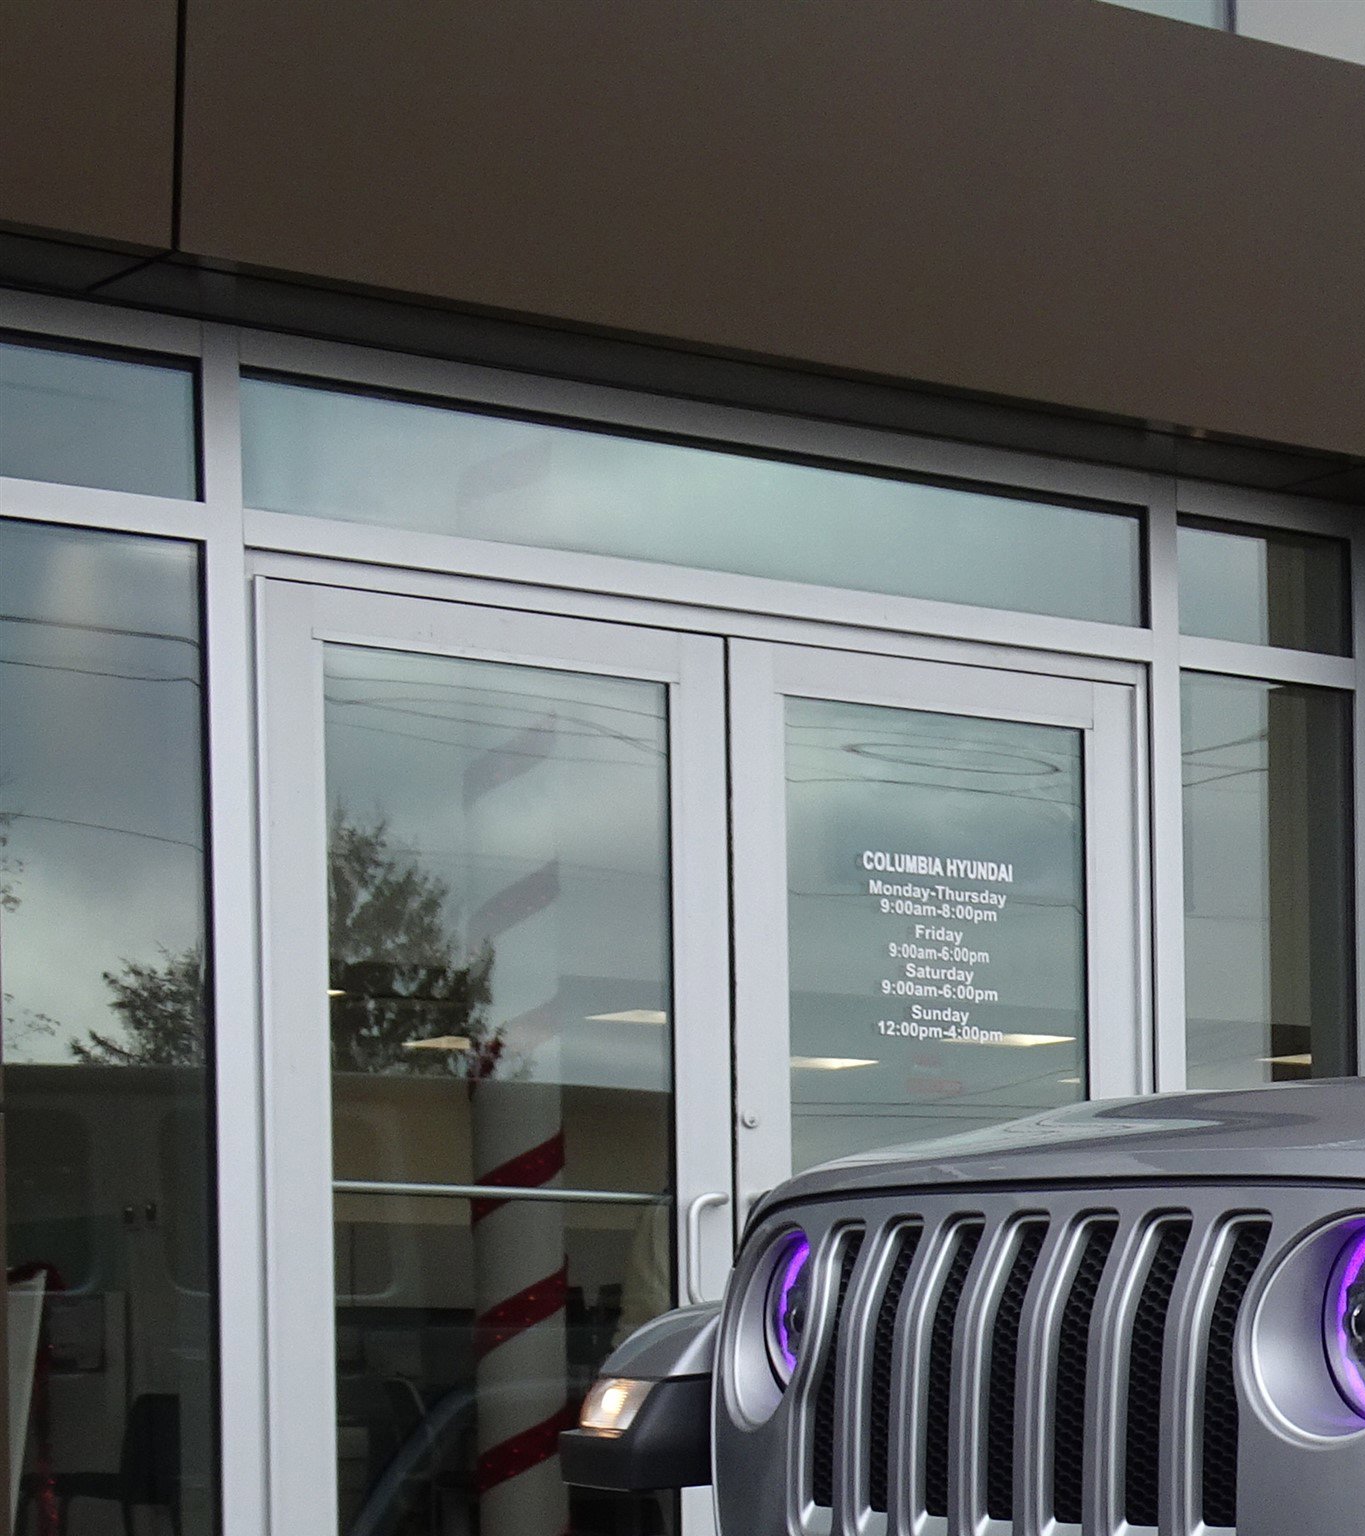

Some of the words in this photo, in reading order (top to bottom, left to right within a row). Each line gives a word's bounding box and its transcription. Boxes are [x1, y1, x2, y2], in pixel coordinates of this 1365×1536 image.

[863, 851, 944, 876] COLUMBIA
[947, 858, 1013, 882] HYUNDAI
[869, 880, 1006, 908] Monday-Thursday
[880, 899, 997, 924] 9:00am-8:00pm
[915, 925, 963, 945] Friday
[889, 943, 990, 965] 9:00am-6:00pm
[905, 963, 974, 985] Saturday
[881, 980, 998, 1003] 9:00am-6:00pm
[911, 1005, 969, 1026] Sunday
[878, 1021, 1003, 1044] 12:00pm-4:00pm
